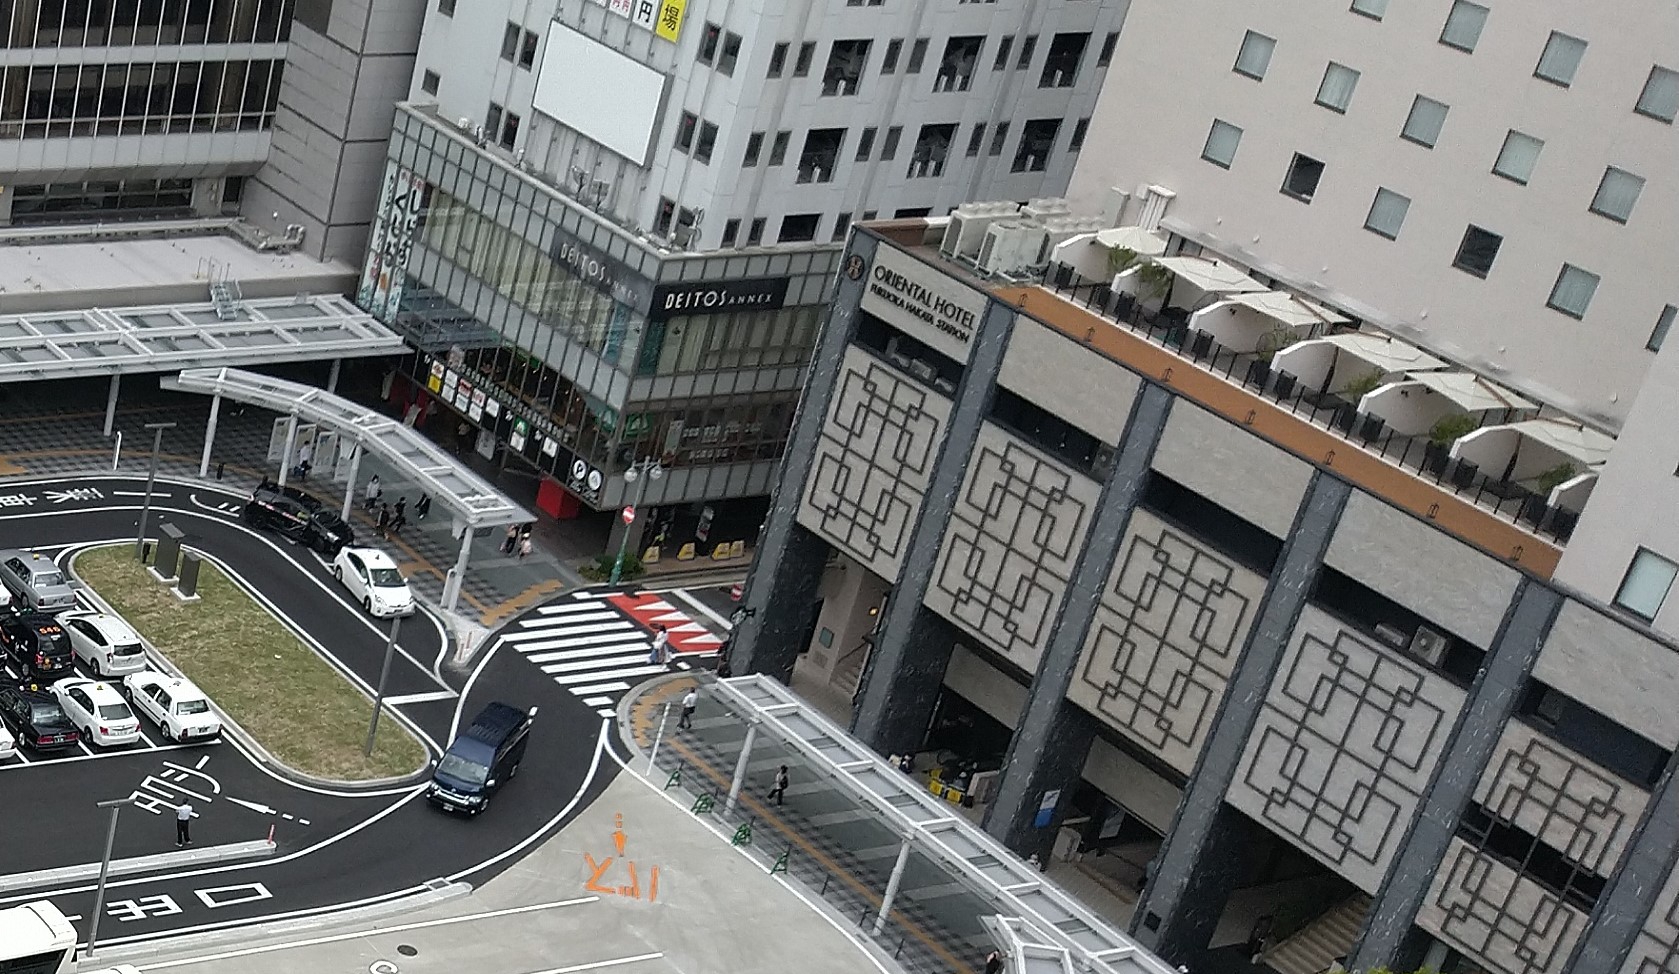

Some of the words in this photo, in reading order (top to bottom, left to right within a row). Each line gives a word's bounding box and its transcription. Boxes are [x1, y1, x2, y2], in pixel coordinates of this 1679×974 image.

[662, 4, 679, 31] 場
[559, 241, 605, 281] DEITOS
[664, 290, 727, 310] DEITOS
[728, 293, 773, 305] ANNEX
[870, 283, 905, 309] FUKUOKA
[905, 301, 934, 325] HAKATA
[936, 319, 970, 344] STATION
[874, 265, 932, 308] ORIENTAL
[933, 294, 976, 331] HOTEL
[128, 755, 221, 818] タクシー
[106, 882, 274, 922] 出口
